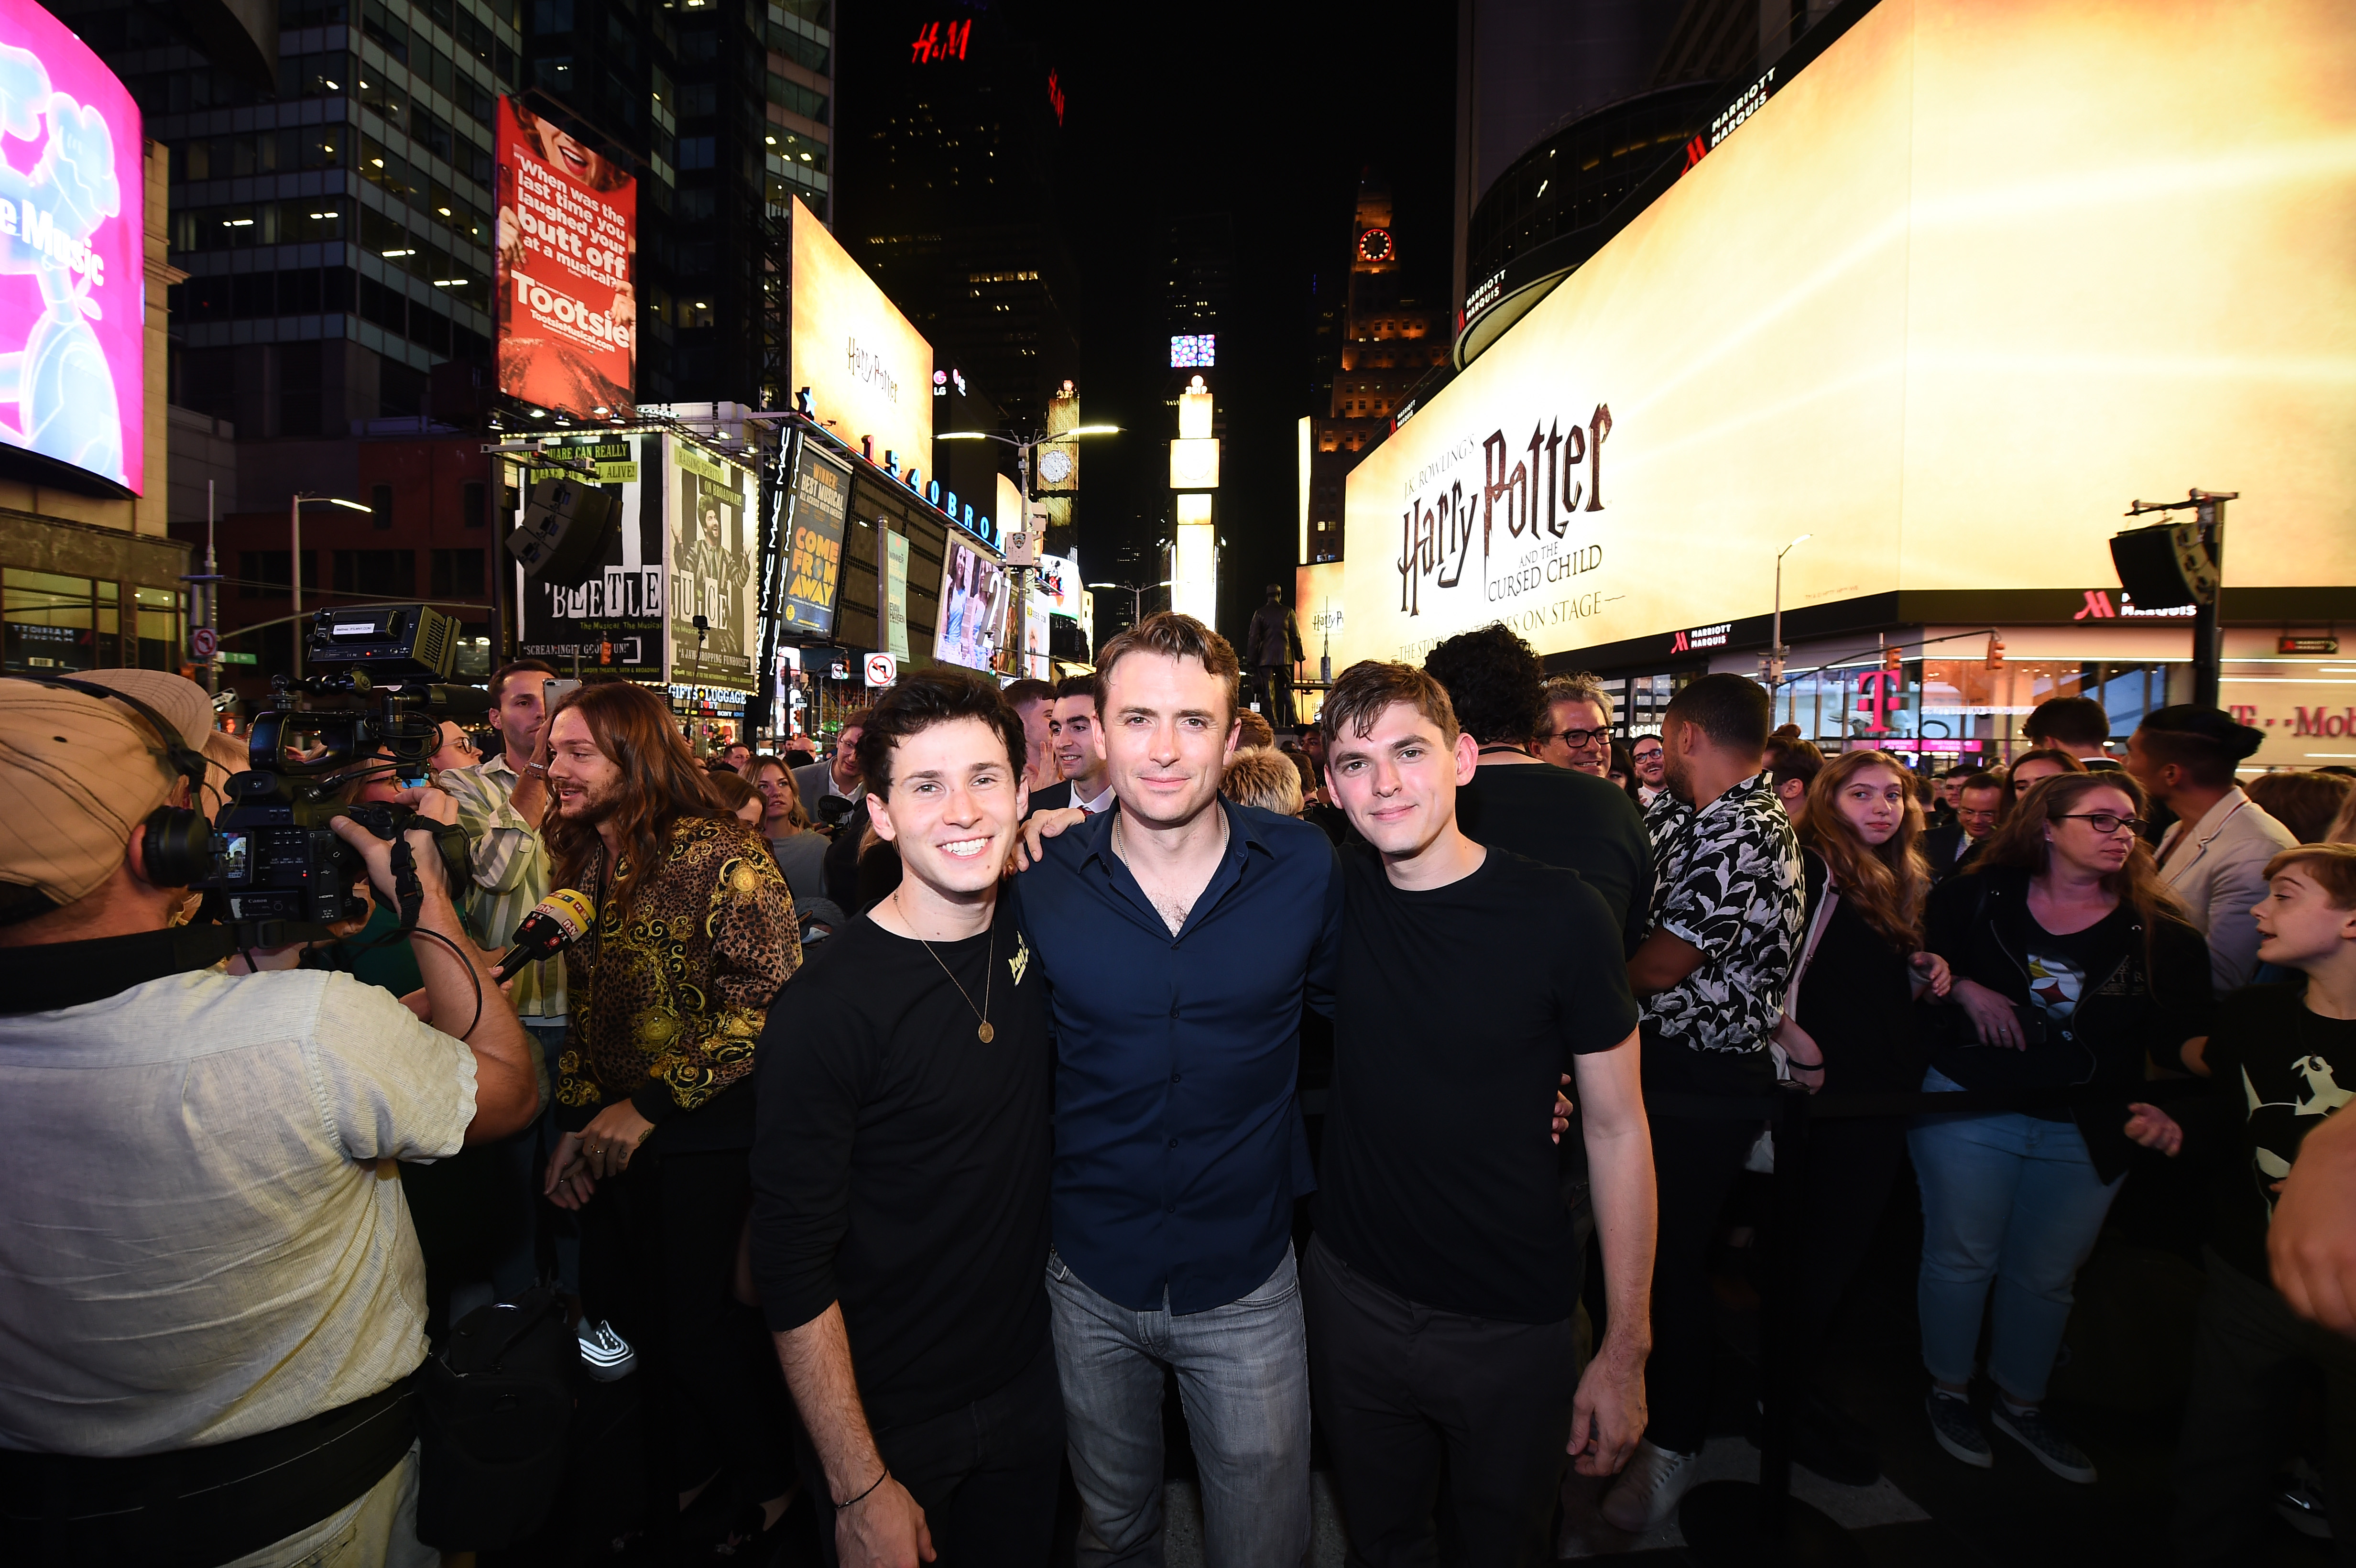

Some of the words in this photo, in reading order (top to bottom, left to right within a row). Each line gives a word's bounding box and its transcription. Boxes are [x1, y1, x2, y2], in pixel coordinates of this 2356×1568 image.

[1712, 67, 1775, 132] MARRIOTT
[1711, 91, 1767, 148] MARQUIS
[518, 169, 550, 200] last
[555, 191, 593, 223] time
[597, 216, 625, 241] you
[518, 186, 588, 236] laughed
[590, 229, 626, 255] your
[570, 187, 599, 212] was
[601, 204, 625, 227] the
[22, 199, 104, 286] Music
[517, 203, 582, 258] butt
[586, 247, 625, 279] off
[523, 236, 540, 252] at
[543, 245, 553, 258] a
[1465, 287, 1500, 321] MARQUIS
[1466, 269, 1506, 308] MARRIOTT
[511, 269, 630, 348] Tootsie
[530, 309, 615, 353] TootsieMusical.com
[846, 336, 873, 383] Harry
[874, 354, 898, 403] Potter
[934, 386, 947, 396] LG
[1397, 399, 1416, 420] MARRIOTT
[641, 407, 677, 418] LAMAR
[1397, 410, 1413, 428] MARQUIS
[546, 446, 573, 460] UARE
[575, 446, 592, 458] CAN
[595, 444, 627, 457] REALLY
[679, 451, 700, 471] RAISING
[701, 463, 720, 482] SPIRITS
[862, 435, 939, 505] 1540
[1418, 433, 1474, 486] ROWLING'S
[607, 465, 635, 478] ALIVE!
[704, 480, 712, 493] ON
[713, 483, 742, 507] BROADWAY!
[801, 473, 818, 497] BEST
[818, 483, 844, 512] MUSICAL
[1397, 478, 1478, 617] Harry
[1483, 403, 1613, 586] Potter
[796, 526, 840, 564] COME
[889, 551, 904, 564] WINNER
[1519, 550, 1538, 568] AND
[1540, 541, 1558, 563] THE
[792, 548, 837, 585] FROM
[1488, 566, 1541, 604] CURSED
[1546, 544, 1602, 583] CHILD
[671, 574, 728, 630] JUICE
[788, 574, 834, 607] AWAY
[889, 602, 900, 614] EVAN
[671, 623, 680, 632] The
[890, 610, 905, 624] HANSEN
[1523, 607, 1546, 631] ON
[1552, 591, 1602, 624] STAGE
[1691, 624, 1732, 638] MARRIOTT
[1691, 635, 1727, 649] MARQUIS
[668, 685, 698, 700] GIFTS
[704, 688, 747, 705] LUGGAGE
[1858, 670, 1901, 732] T
